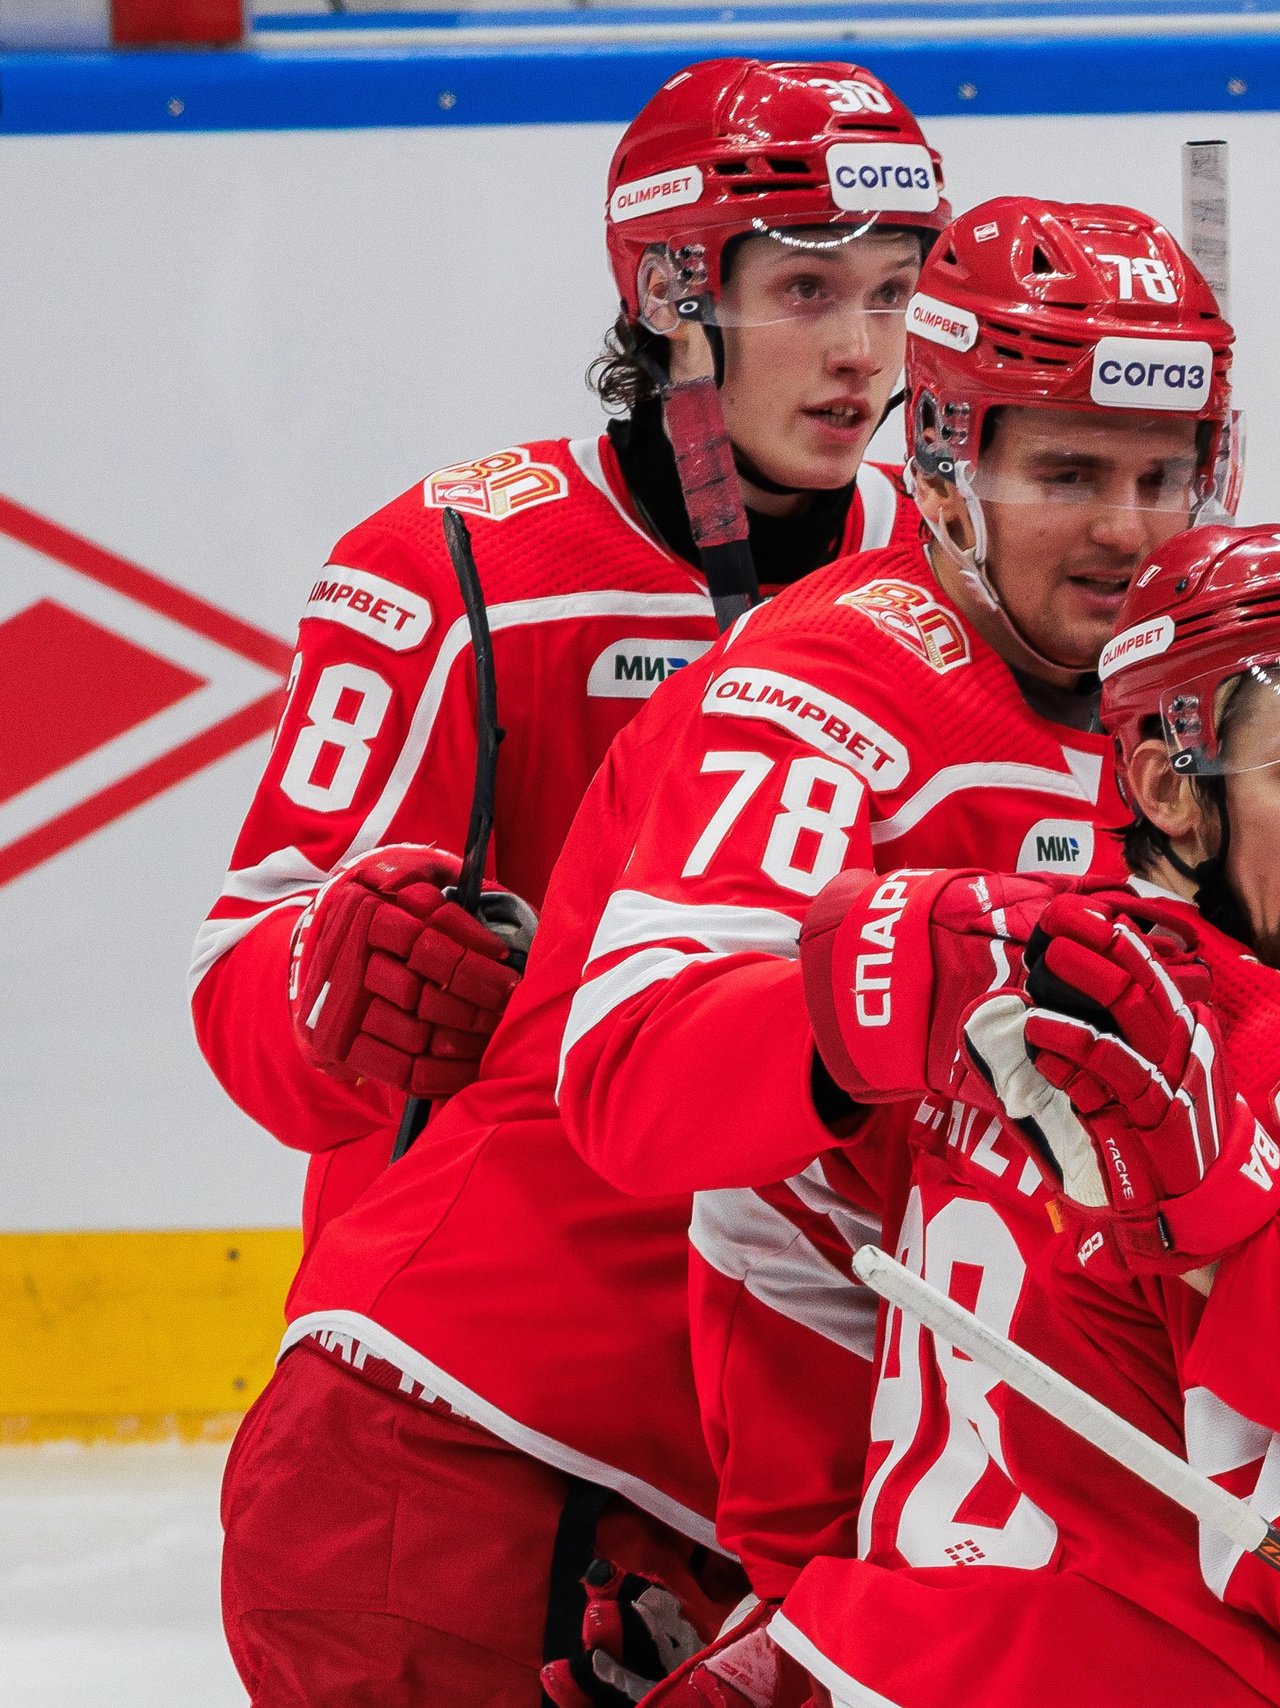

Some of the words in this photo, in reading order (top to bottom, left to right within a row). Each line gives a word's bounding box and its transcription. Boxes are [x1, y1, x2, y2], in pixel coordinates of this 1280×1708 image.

[617, 176, 692, 209] OLIMPBET
[1096, 254, 1178, 304] 78
[913, 306, 969, 338] OLIMPBET
[1103, 626, 1164, 667] OLIMPBET
[716, 680, 896, 773] OLIMPBET
[682, 750, 865, 898] 78
